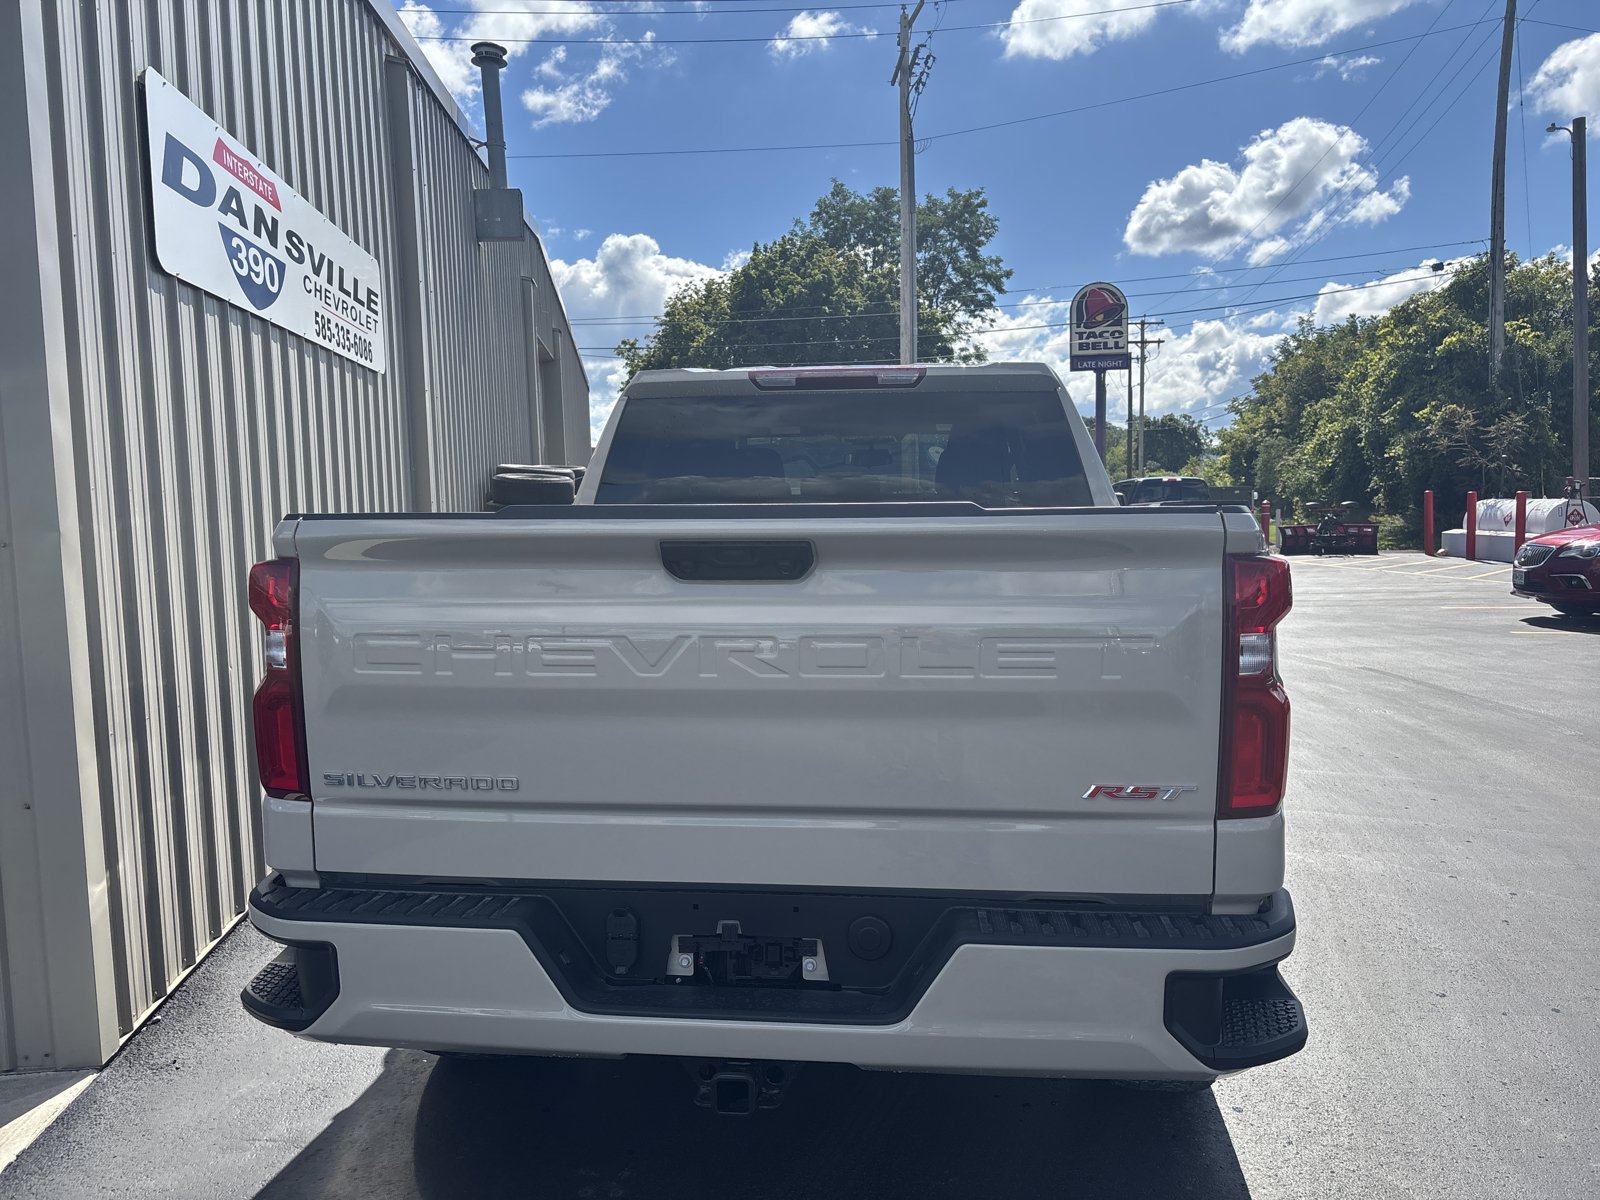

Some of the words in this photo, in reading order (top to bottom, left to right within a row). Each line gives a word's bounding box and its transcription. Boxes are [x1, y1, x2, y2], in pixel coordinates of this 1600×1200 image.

[223, 149, 274, 202] INTERSTATE
[161, 131, 379, 316] DANSVILLE
[231, 236, 279, 294] 390
[303, 274, 379, 334] CHEVROLET
[314, 310, 373, 364] 585-335-6086
[1075, 330, 1124, 340] TACO
[1078, 341, 1125, 351] BELL
[353, 633, 1158, 679] CHEVROLET
[323, 772, 520, 791] SILVERADO
[1081, 784, 1198, 800] RST
